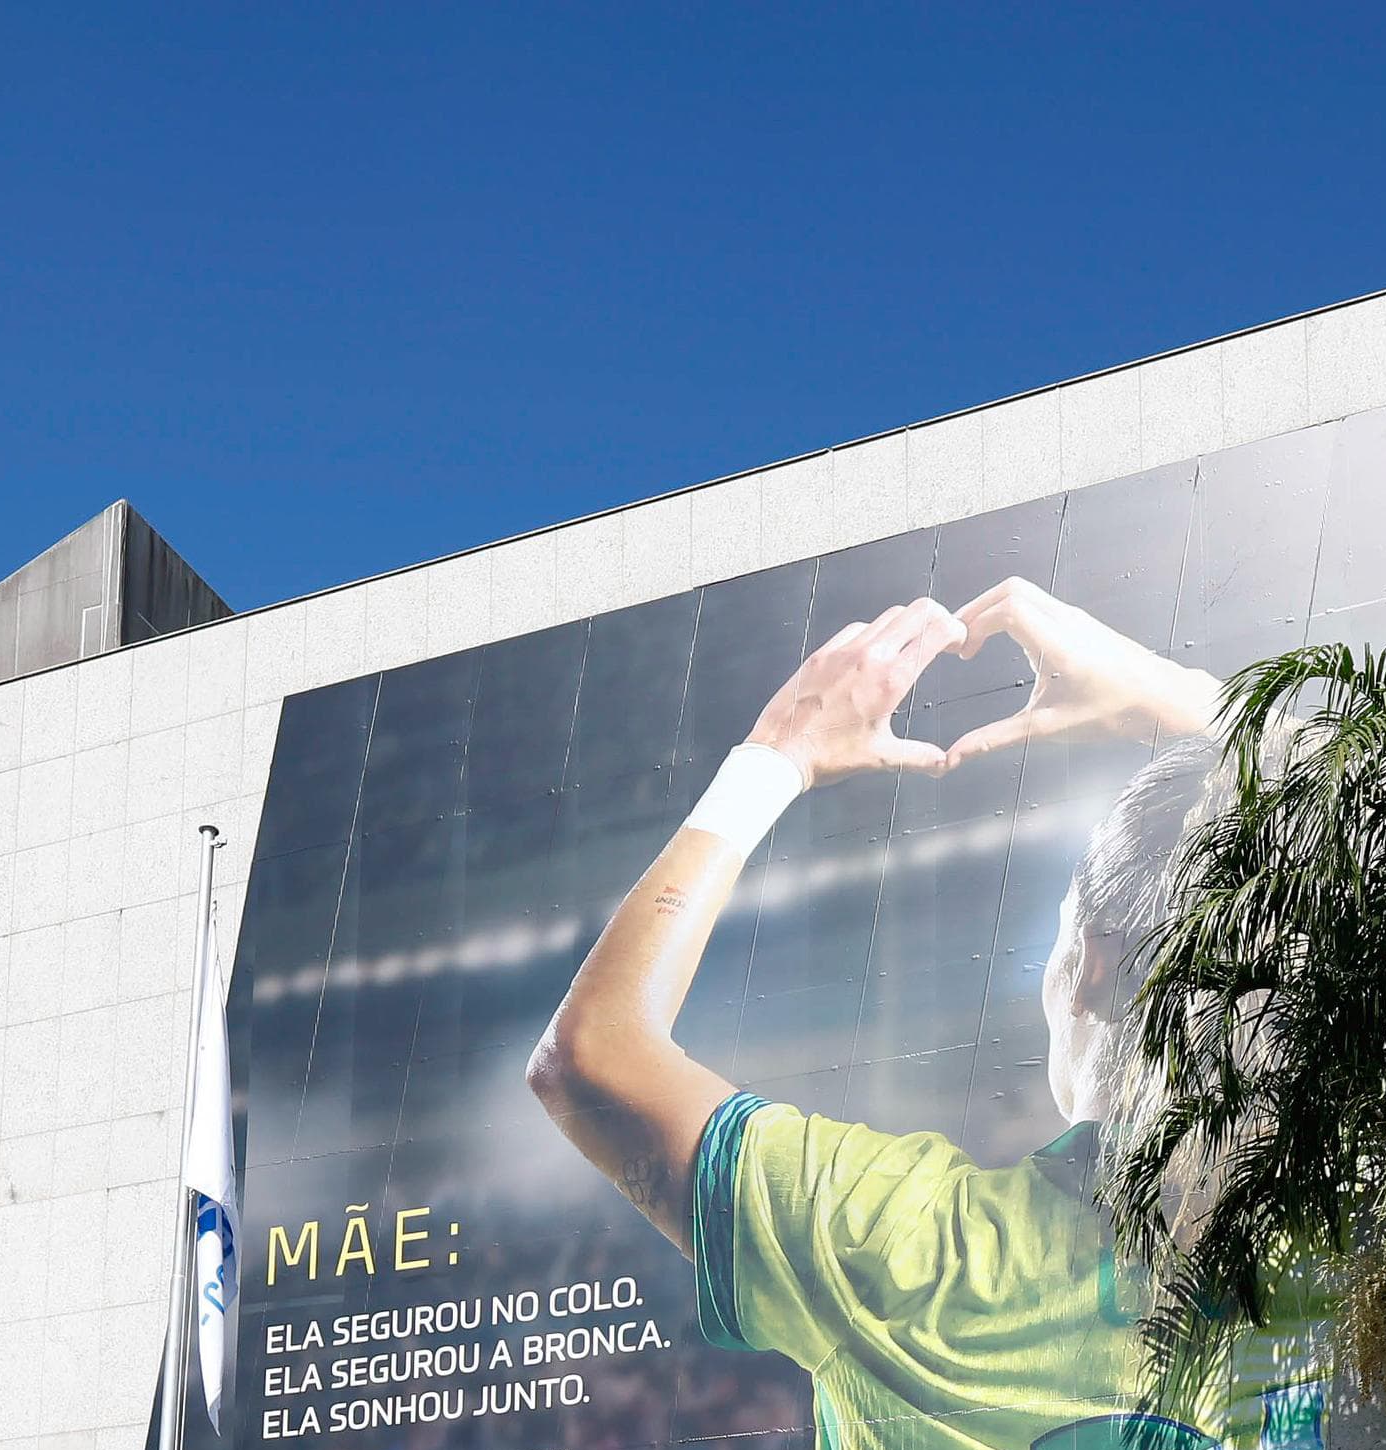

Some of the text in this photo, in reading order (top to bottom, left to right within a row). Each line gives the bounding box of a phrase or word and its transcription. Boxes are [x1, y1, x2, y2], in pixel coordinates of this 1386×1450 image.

[266, 1202, 460, 1286] MÃE:
[266, 1276, 644, 1355] ELA SEGUROU NO COLO.
[264, 1320, 672, 1397] ELA SEGUROU A BRONCA.
[262, 1373, 591, 1440] ELA SONHOU JUNTO.
